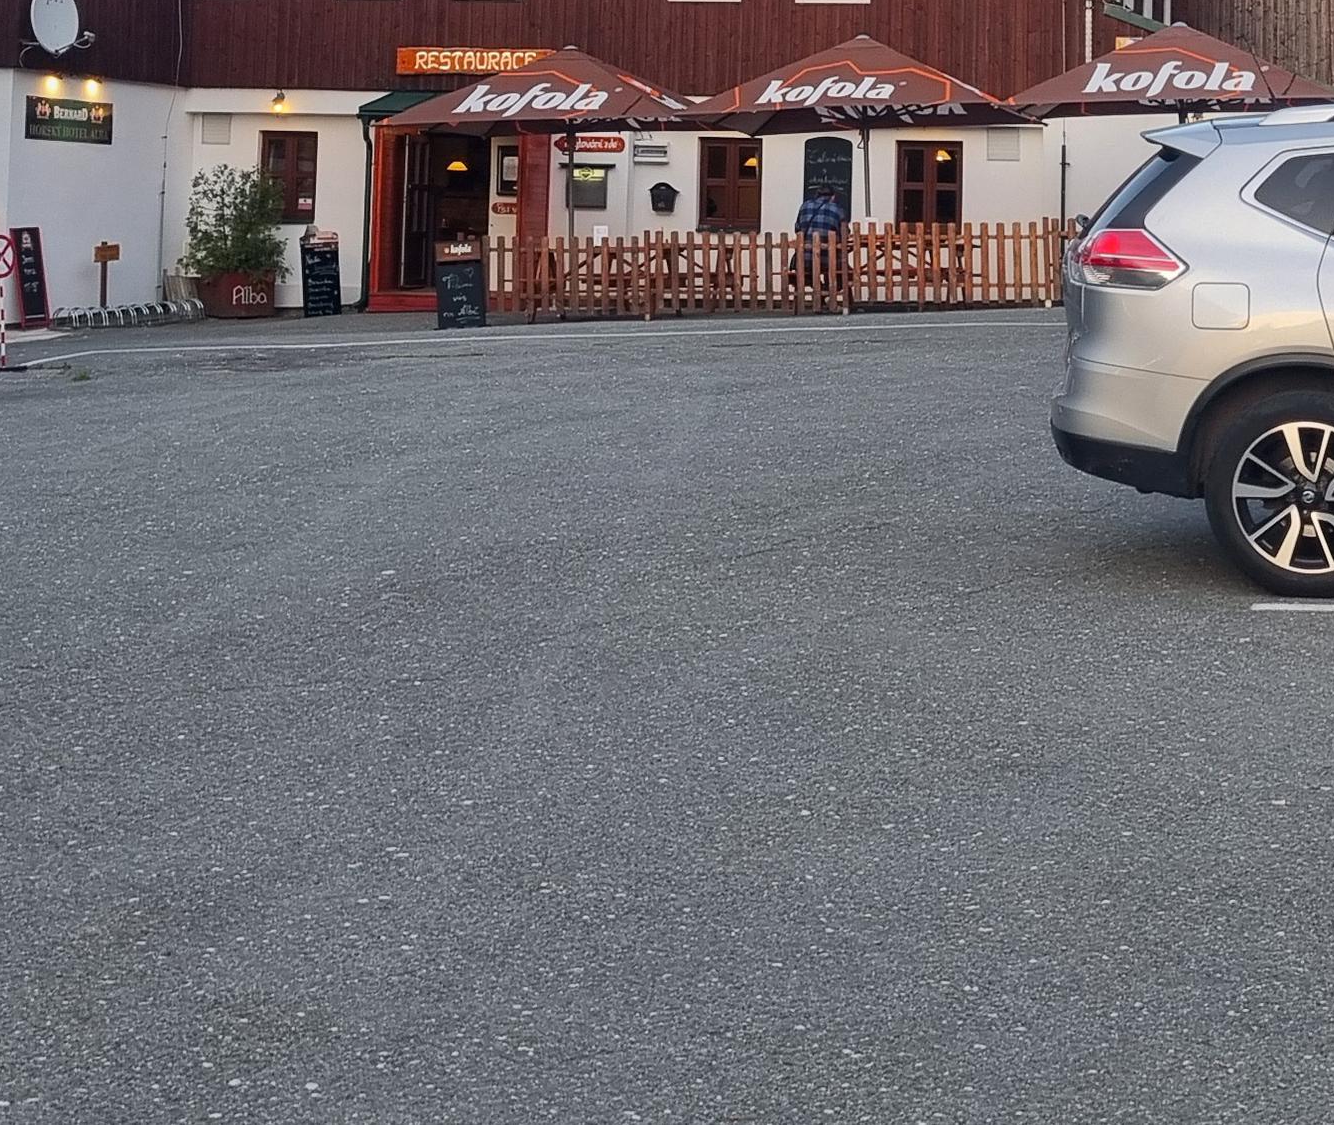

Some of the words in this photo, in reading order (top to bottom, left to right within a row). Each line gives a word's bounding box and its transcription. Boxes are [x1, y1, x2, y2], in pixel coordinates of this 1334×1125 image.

[414, 50, 537, 71] RESTAURACE
[754, 76, 895, 106] kofola
[1082, 61, 1256, 98] kofola
[451, 82, 609, 117] kofola
[232, 285, 267, 305] Alba
